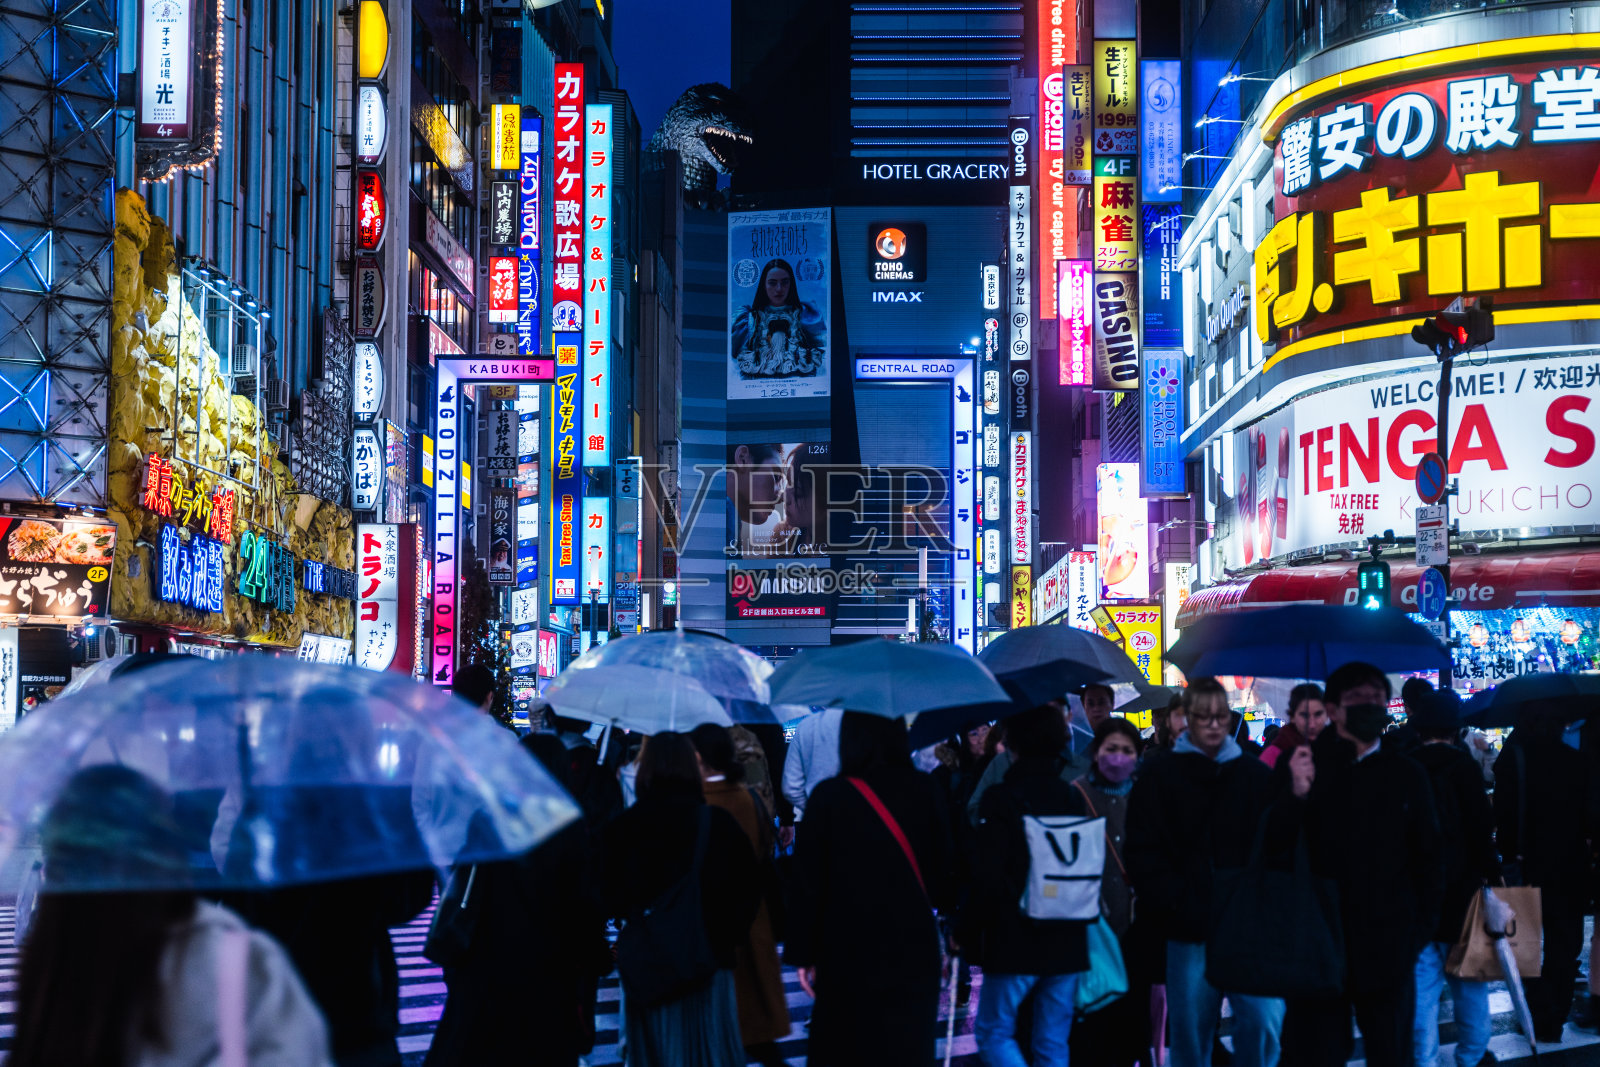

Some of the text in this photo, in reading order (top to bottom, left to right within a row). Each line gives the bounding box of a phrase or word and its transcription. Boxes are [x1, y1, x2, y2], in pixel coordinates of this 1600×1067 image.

[1051, 28, 1066, 66] drink
[155, 83, 174, 104] 光
[1105, 47, 1121, 107] 生ビール
[1071, 72, 1084, 121] 生ビール
[156, 124, 173, 136] 4F
[1011, 127, 1028, 177] Booth
[1103, 159, 1131, 175] 4F
[555, 71, 581, 291] カラオケ歌広場
[863, 164, 1008, 180] HOTEL GRACERY
[1052, 183, 1063, 208] our
[1100, 180, 1134, 243] 麻雀
[875, 262, 903, 271] TOHO
[1098, 247, 1129, 257] スリー
[875, 271, 914, 280] CINEMAS
[872, 291, 924, 302] IMAX
[1096, 280, 1139, 384] CASINO
[559, 347, 577, 364] 薬
[861, 364, 955, 373] CENTRAL ROAD
[358, 413, 371, 421] 1F
[557, 373, 578, 479] マツモトキヨシ
[1153, 401, 1165, 448] STAGE
[1165, 401, 1176, 439] IDOL
[356, 435, 373, 444] 新宿
[1300, 404, 1508, 494] TENGA
[355, 445, 374, 490] かっぱ
[1015, 444, 1026, 488] カラオケ
[1153, 462, 1175, 477] 5F
[356, 494, 372, 504] B1
[436, 408, 455, 563] GODZILLA
[1330, 494, 1379, 509] TAX FREE
[1400, 483, 1593, 520] KUKICHO
[494, 495, 508, 536] 海の家
[560, 494, 573, 567] Tax Free Shop
[1338, 512, 1364, 535] 免税
[383, 527, 397, 579] 大衆酒場
[956, 430, 971, 640] ゴジラロード
[90, 569, 105, 579] 2F
[361, 533, 382, 622] トラノコ
[435, 582, 453, 656] ROAD
[1115, 611, 1160, 623] カラオケ
